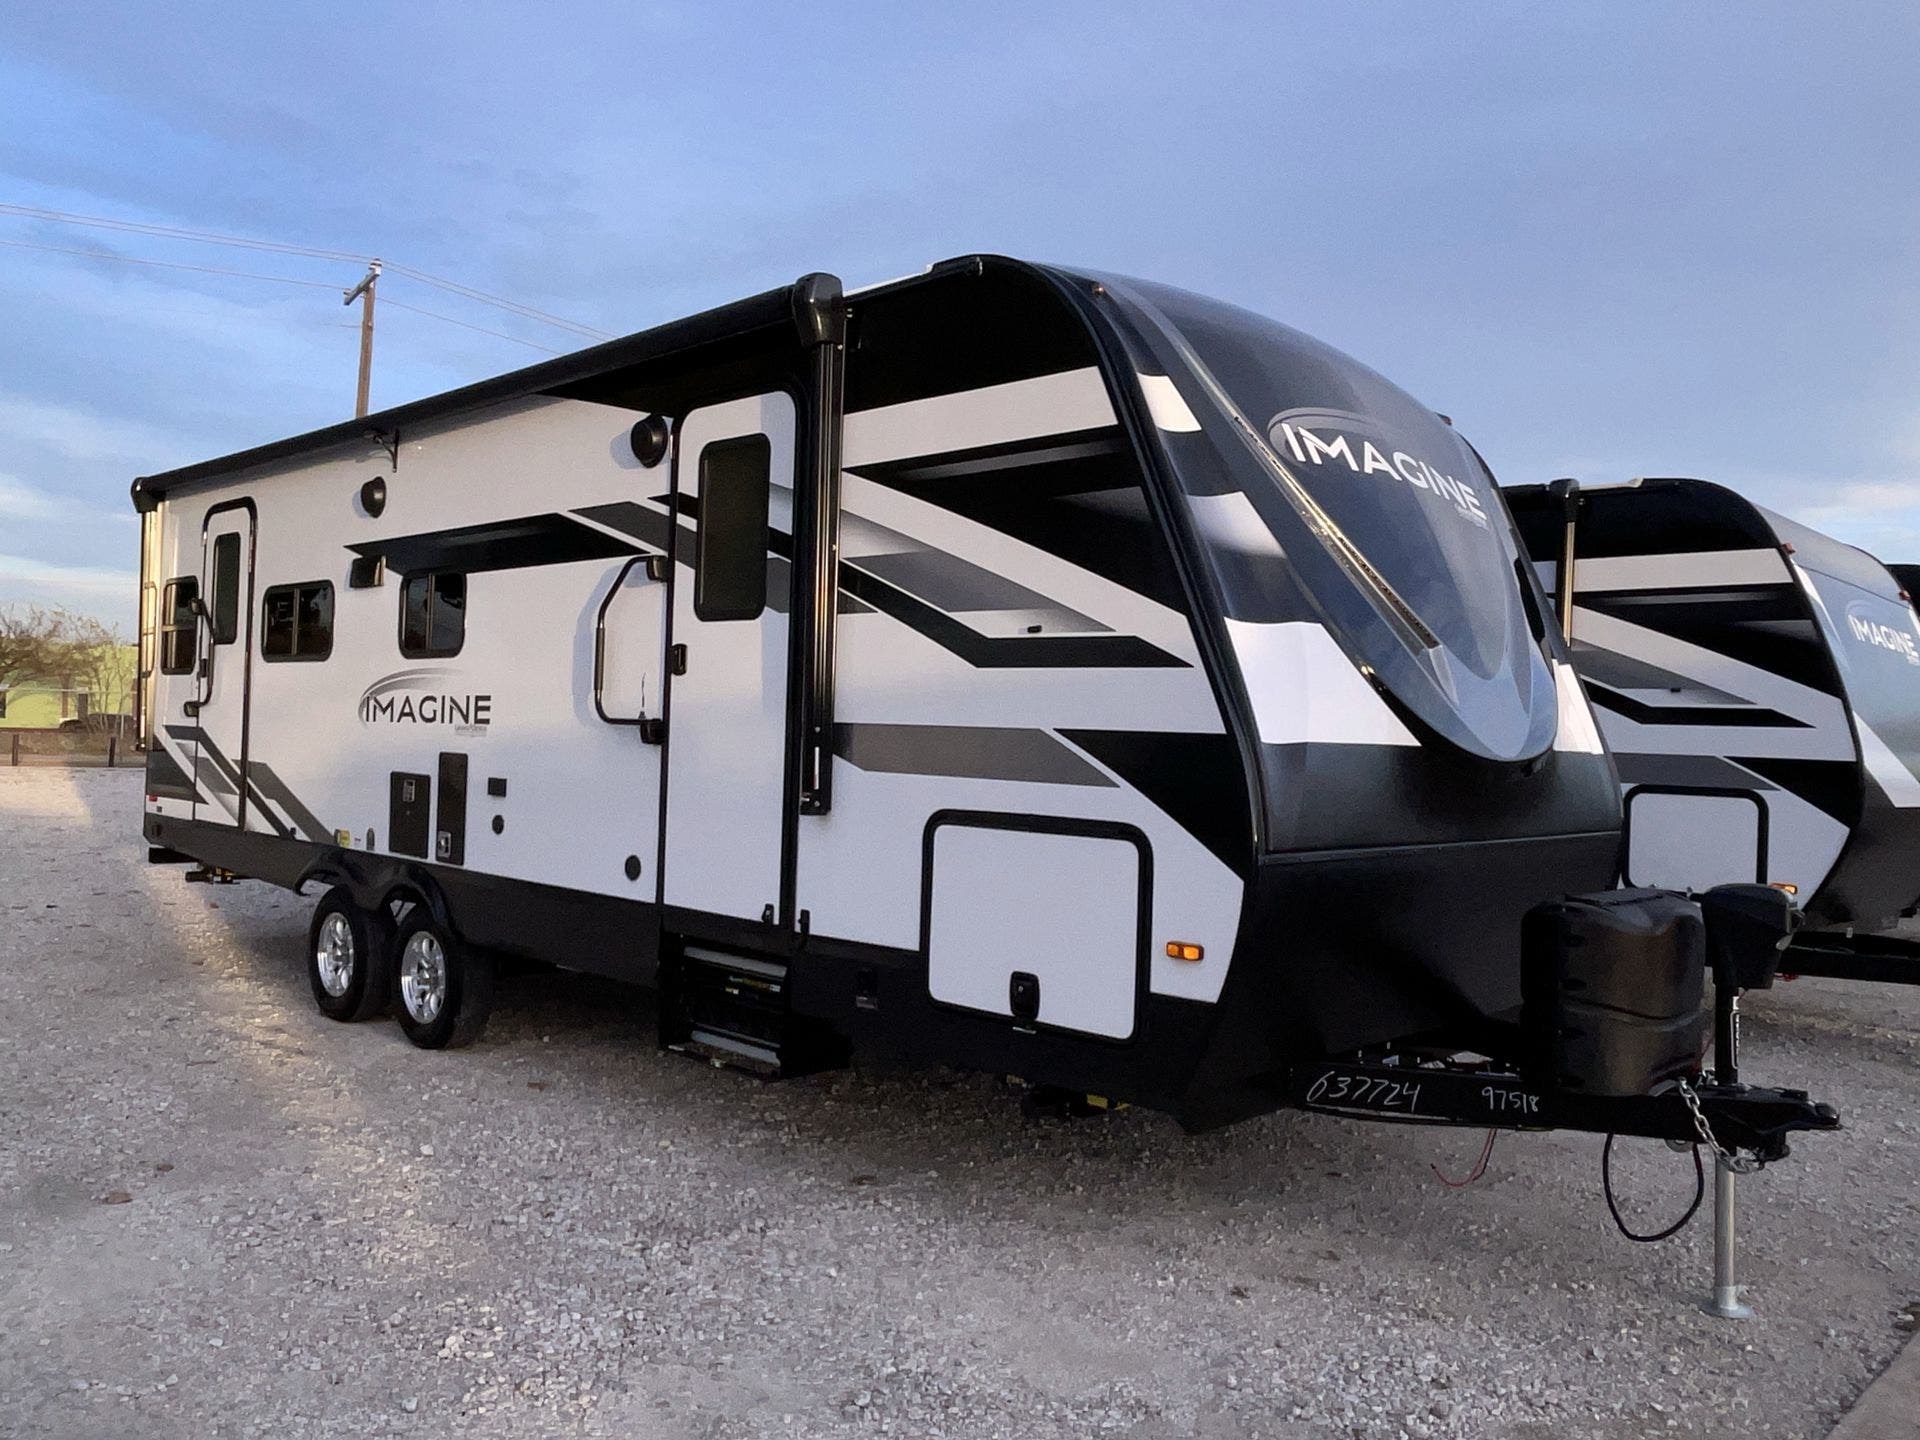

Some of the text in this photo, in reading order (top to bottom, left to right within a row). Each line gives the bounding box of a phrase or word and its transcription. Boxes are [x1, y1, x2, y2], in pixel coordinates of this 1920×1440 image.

[1281, 422, 1488, 521] IMAGINE
[1848, 614, 1919, 657] IMAGINE
[365, 695, 492, 725] IMAGINE
[1306, 1070, 1421, 1113] 637724
[1481, 1086, 1540, 1114] 97518
